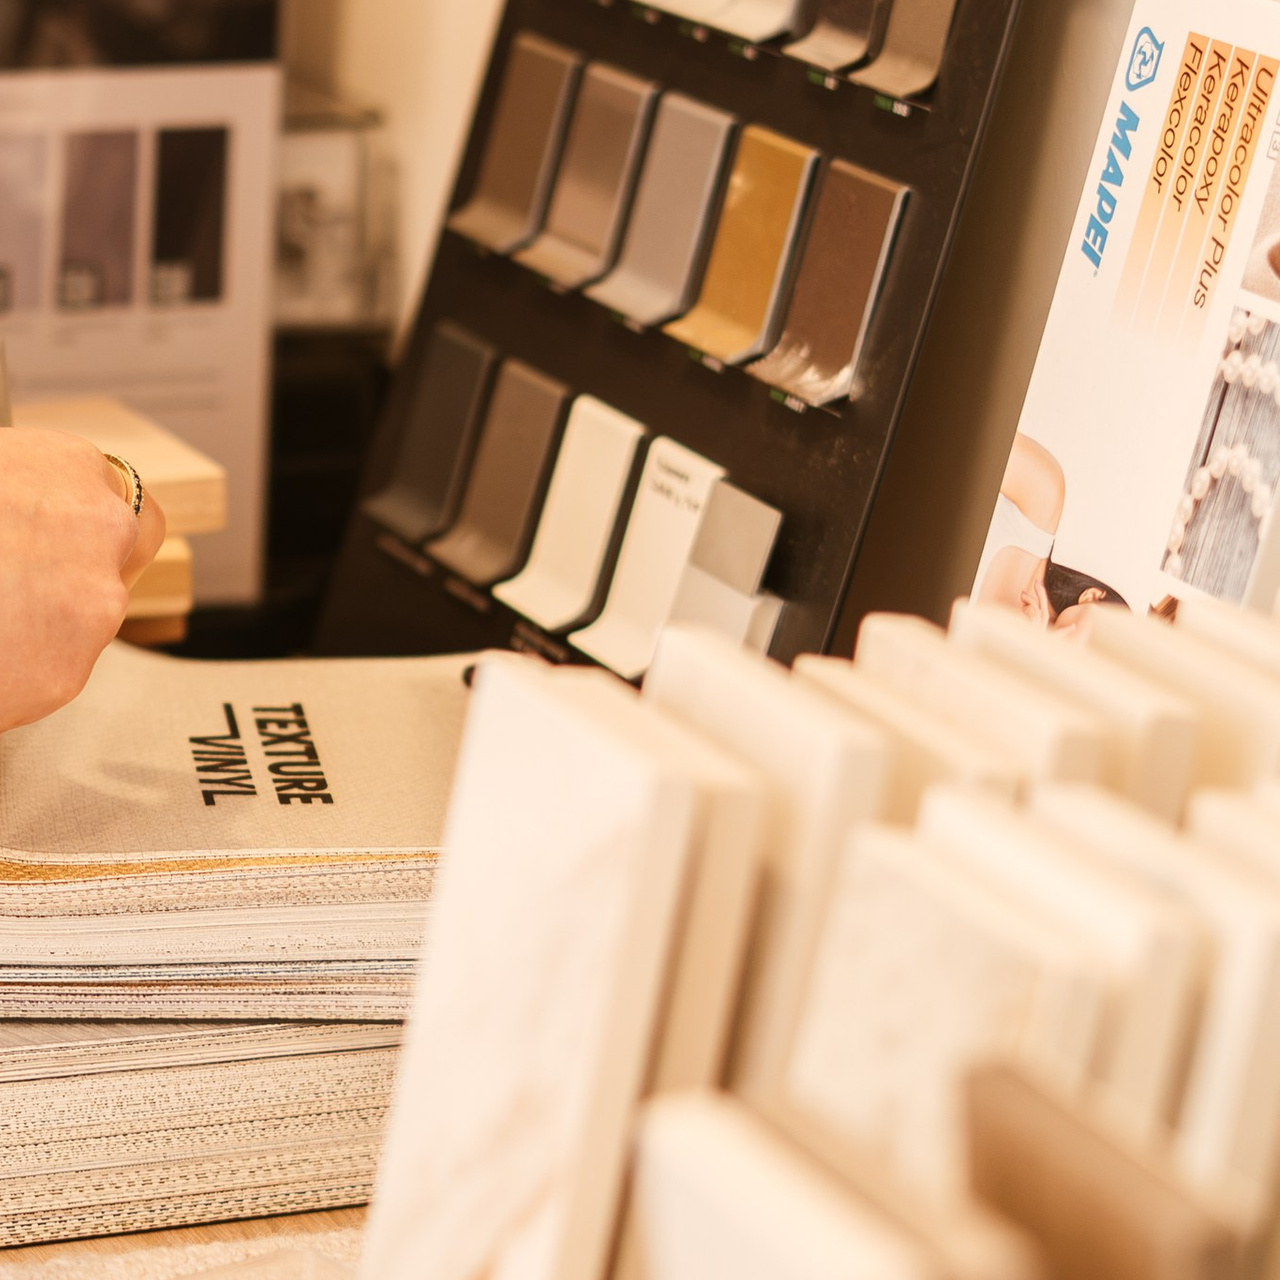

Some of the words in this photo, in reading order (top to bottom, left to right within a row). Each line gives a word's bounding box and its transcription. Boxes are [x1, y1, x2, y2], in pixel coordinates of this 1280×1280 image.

[1081, 100, 1140, 270] MAPEI
[1152, 41, 1204, 194] Flexcolor
[1173, 49, 1227, 212] Keracolor
[1194, 56, 1250, 215] Kerapoxy
[1218, 67, 1273, 233] Ultracolor
[1193, 236, 1225, 309] Plus
[188, 702, 258, 806] VINYL
[251, 702, 334, 805] TEXTURE
